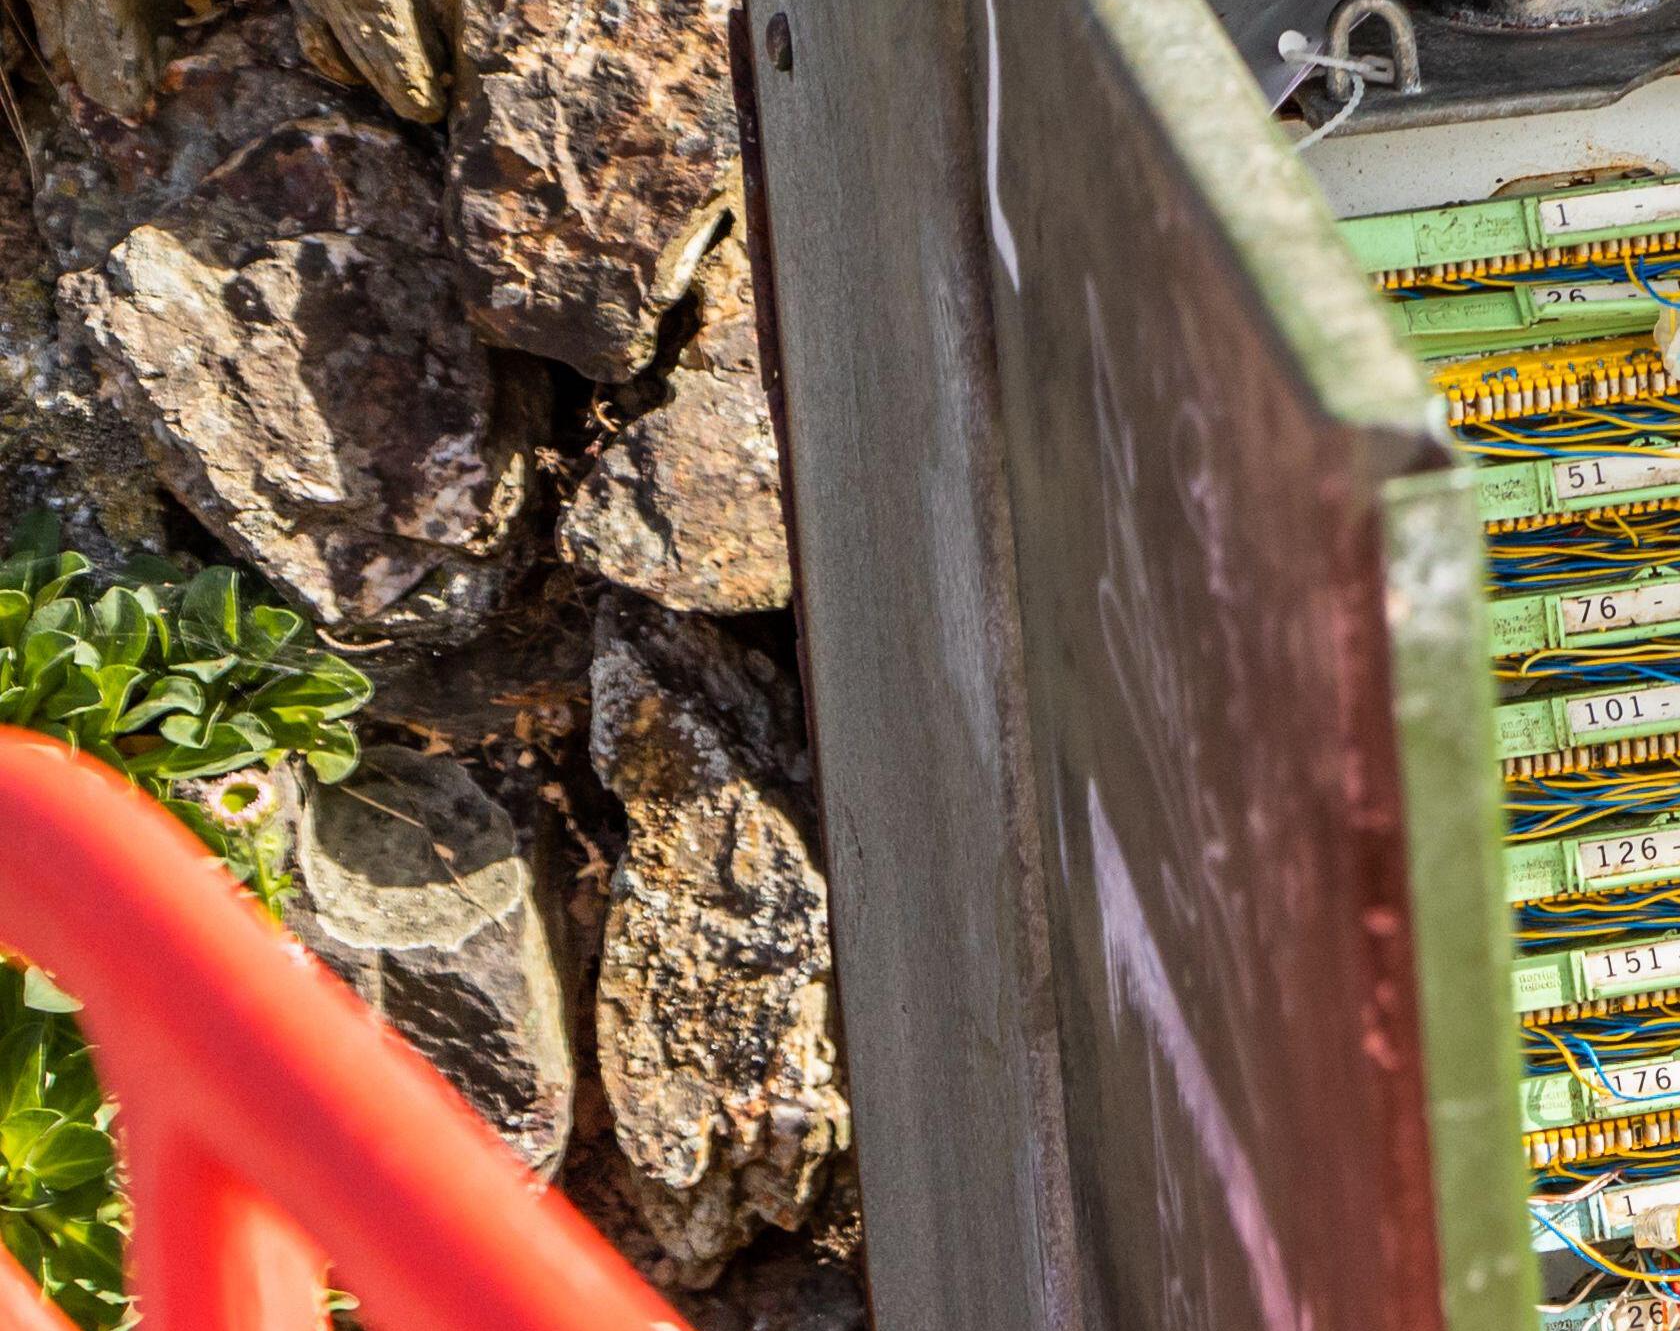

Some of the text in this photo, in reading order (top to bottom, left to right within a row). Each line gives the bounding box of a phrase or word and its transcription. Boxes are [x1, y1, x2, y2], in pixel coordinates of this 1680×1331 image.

[1556, 203, 1570, 227] 1
[1568, 462, 1607, 490] 51
[1578, 596, 1617, 624] 76
[1585, 695, 1644, 725] 101
[1598, 837, 1657, 868] 126
[1604, 947, 1662, 978] 151
[1613, 1067, 1672, 1094] 176
[1624, 1195, 1637, 1218] 1
